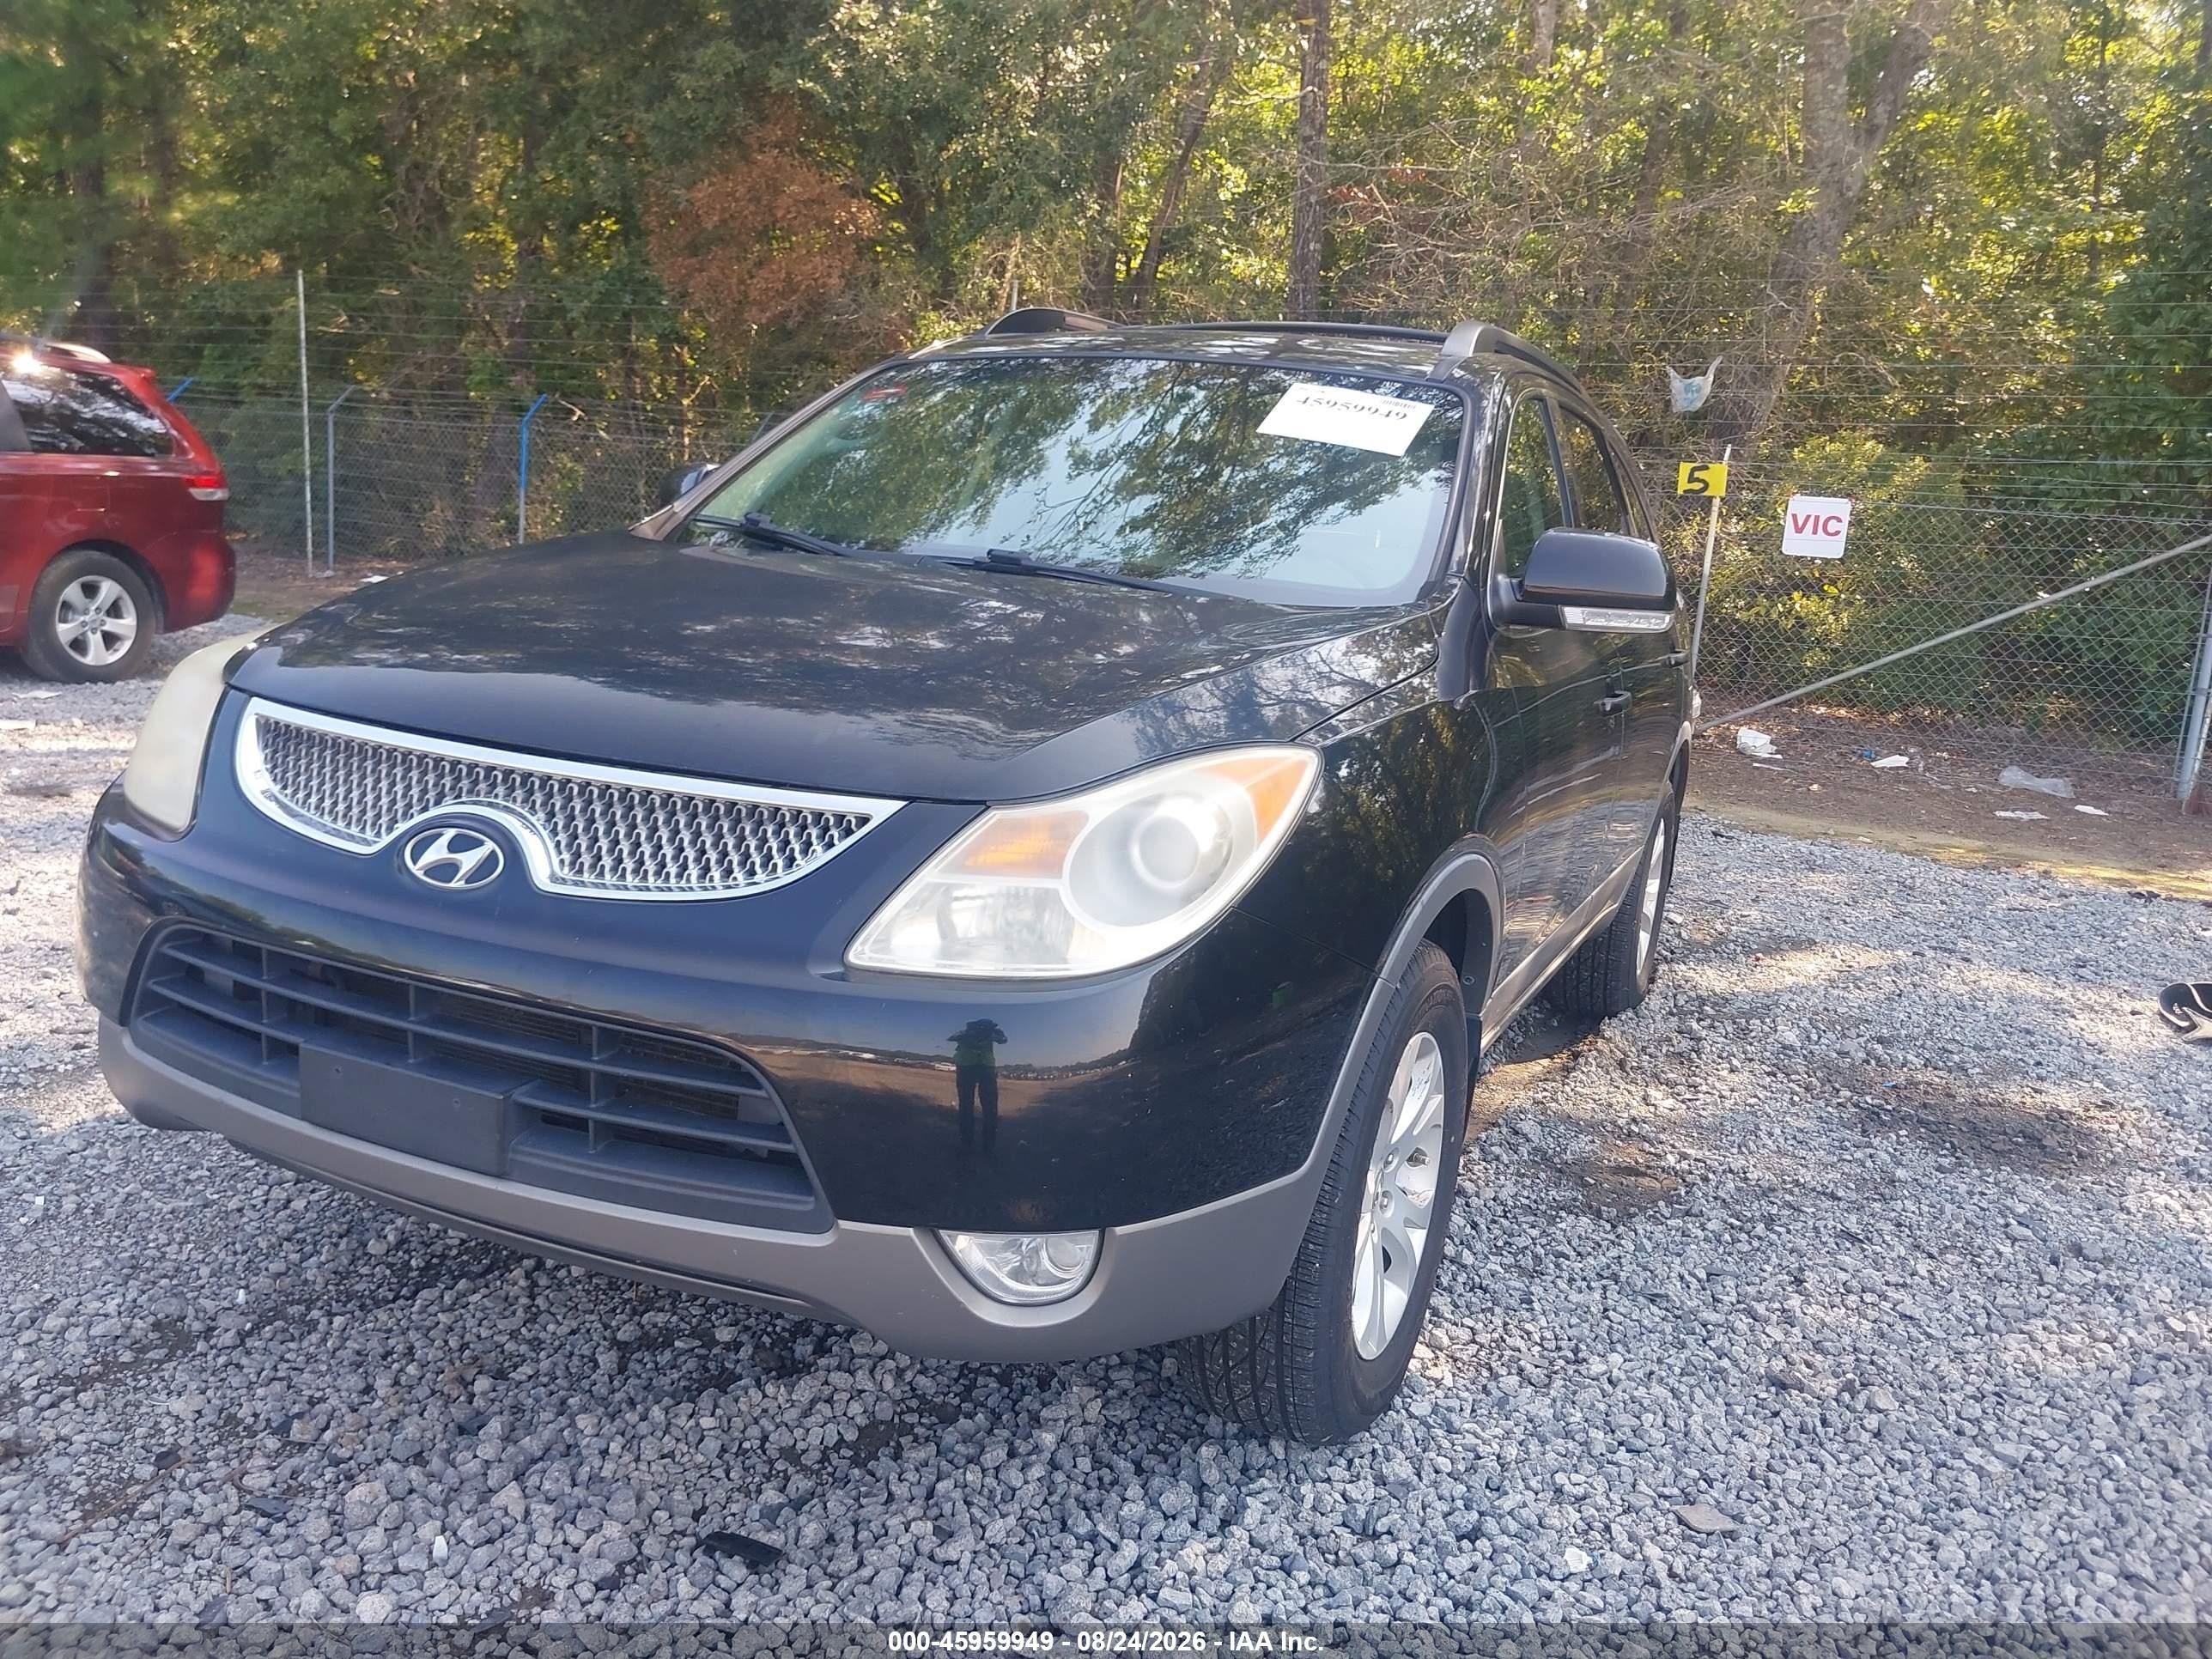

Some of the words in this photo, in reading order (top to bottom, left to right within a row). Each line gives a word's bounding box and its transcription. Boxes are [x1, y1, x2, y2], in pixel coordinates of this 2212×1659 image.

[1297, 396, 1408, 420] 45959949
[1682, 464, 1711, 495] 5
[1790, 513, 1844, 537] VIC
